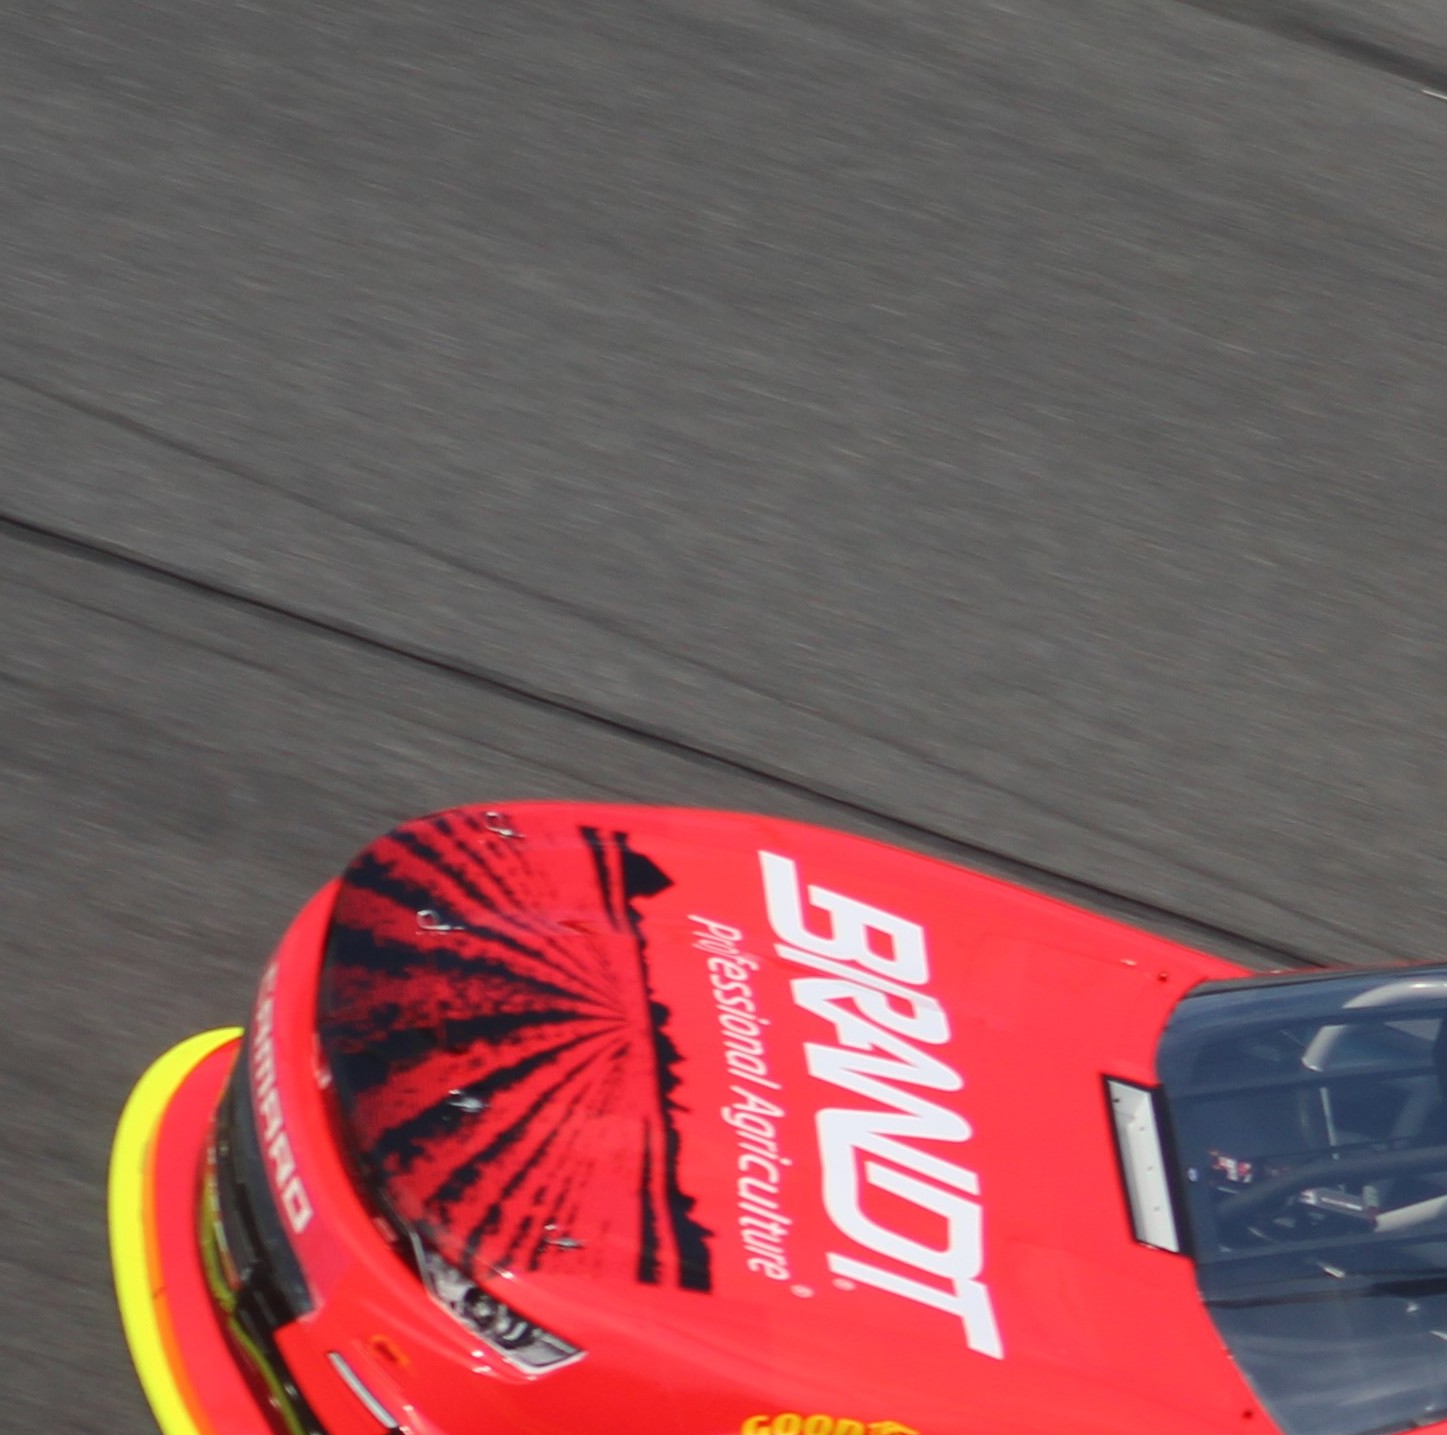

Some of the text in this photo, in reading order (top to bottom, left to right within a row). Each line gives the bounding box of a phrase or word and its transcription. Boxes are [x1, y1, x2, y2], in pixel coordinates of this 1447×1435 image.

[688, 914, 793, 1281] Professional Agriculture
[758, 850, 1004, 1360] BRANDT
